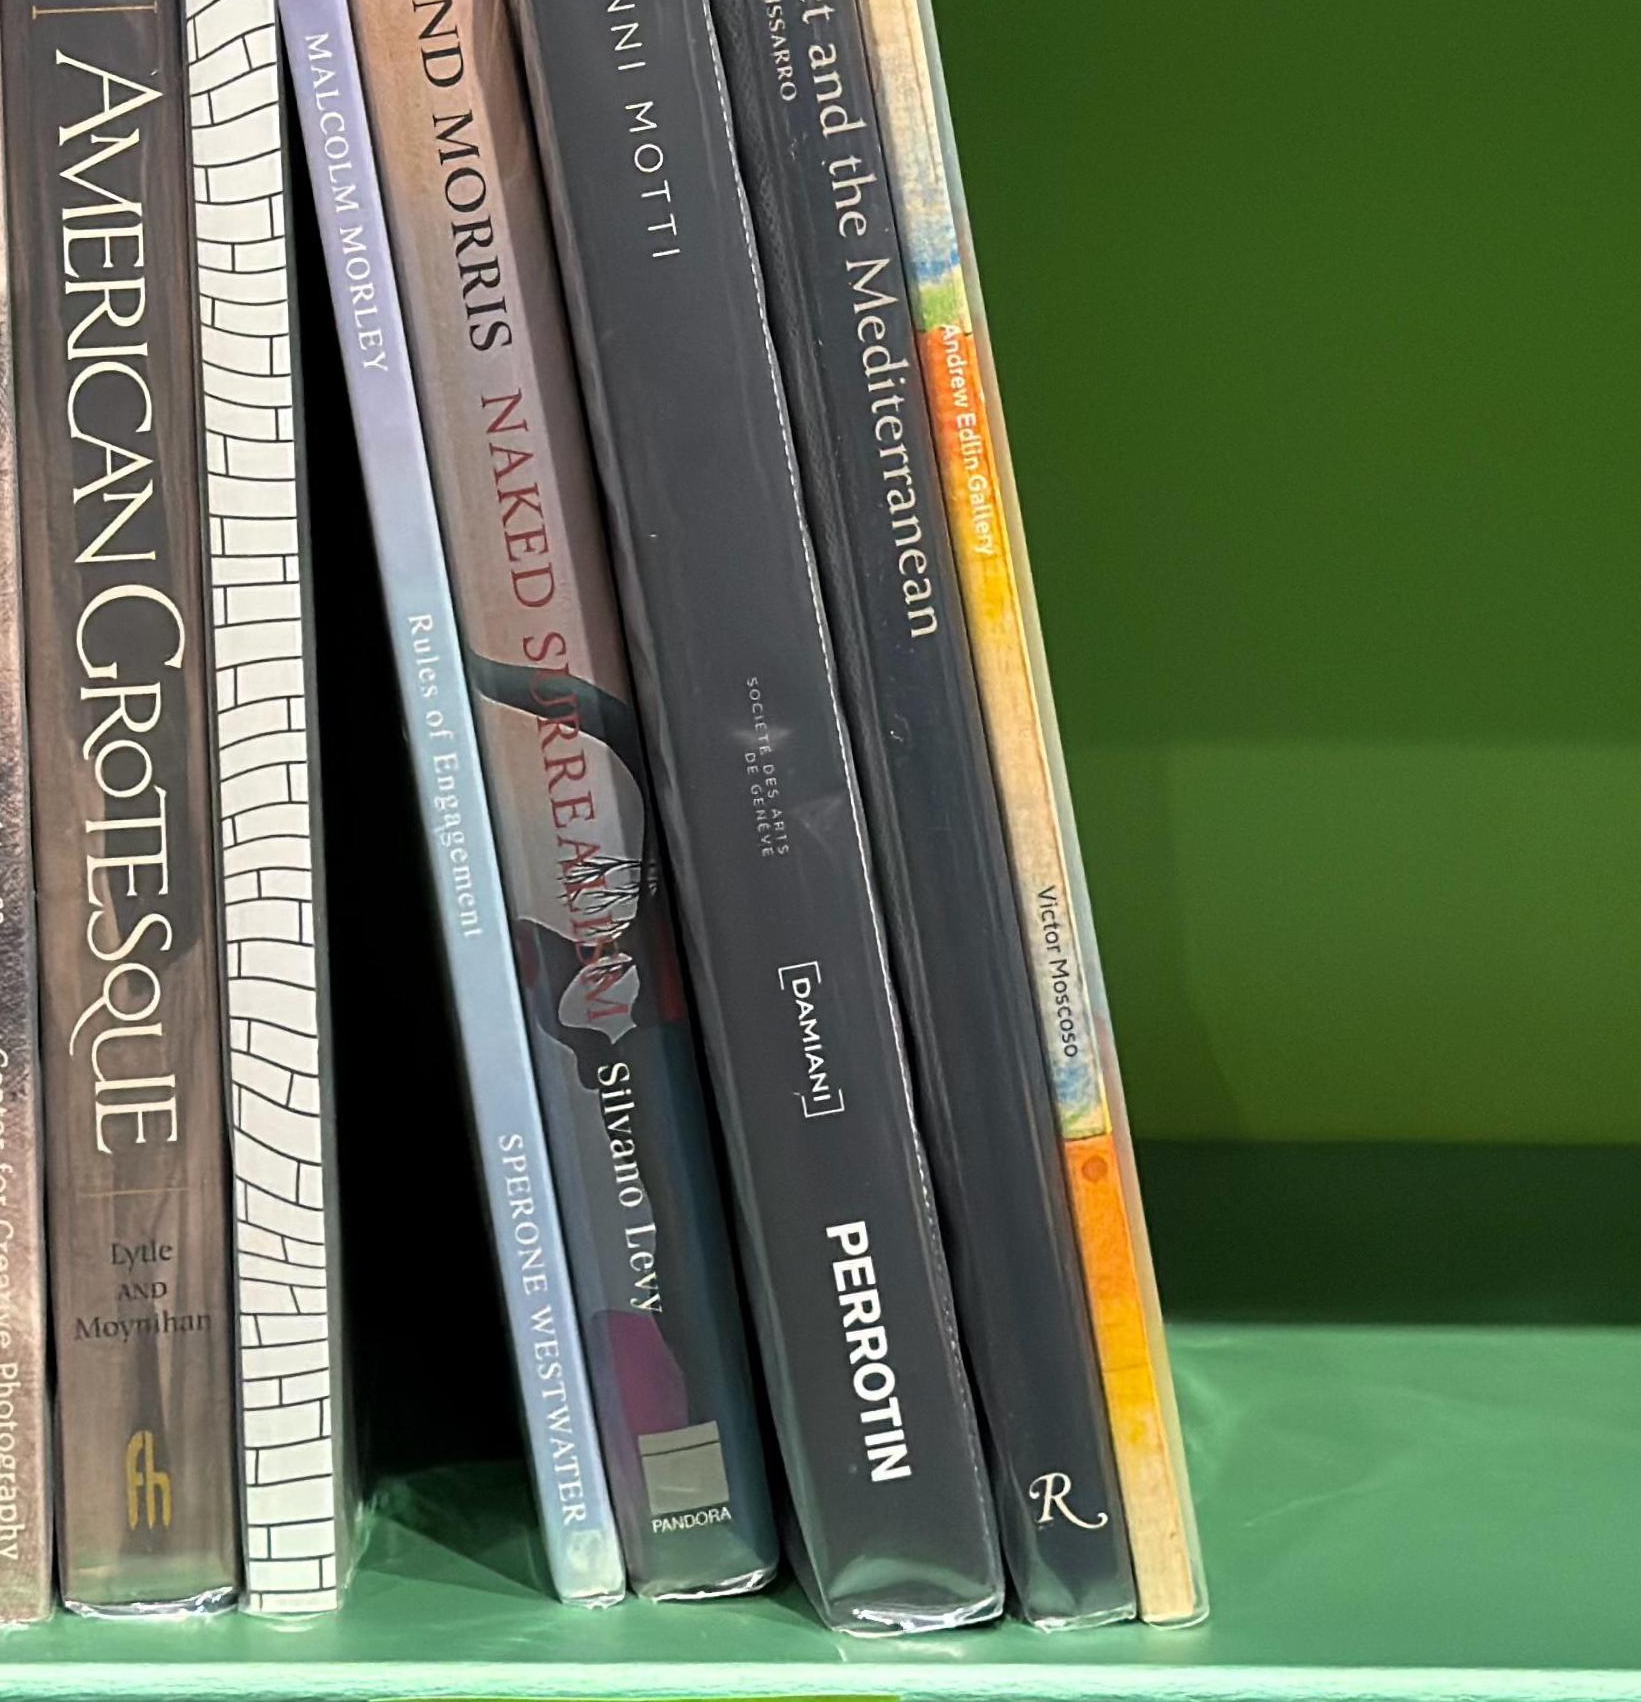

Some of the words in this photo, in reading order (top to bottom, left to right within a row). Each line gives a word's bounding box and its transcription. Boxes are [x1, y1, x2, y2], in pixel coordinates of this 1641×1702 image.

[806, 43, 856, 137] and
[304, 31, 359, 214] MALCOLM
[338, 225, 389, 376] MORLEY
[624, 100, 682, 260] MOTTI
[827, 157, 878, 241] the
[429, 112, 512, 352] MORRIS
[56, 49, 163, 565] AMERICAN
[939, 322, 975, 409] Andrew
[844, 257, 944, 639] Mediterranean
[954, 412, 987, 472] Edlin
[478, 388, 556, 609] NAKED
[963, 475, 998, 557] Gallery
[406, 613, 442, 699] Rules
[423, 710, 452, 742] of
[745, 752, 759, 776] DE
[762, 764, 779, 799] DES
[69, 584, 186, 1155] GROTESQUE
[431, 753, 486, 939] Engagement
[523, 634, 632, 1027] SURREALISM
[770, 808, 790, 856] ARTS
[1035, 884, 1064, 954] Victor
[1048, 958, 1082, 1058] Moscoso
[597, 1062, 653, 1209] Silvano
[111, 1240, 173, 1273] Lytle
[118, 1281, 168, 1301] AND
[623, 1224, 670, 1315] Levy
[75, 1310, 211, 1343] Moynihan
[498, 1132, 549, 1296] SPERONE
[527, 1306, 588, 1526] WESTWATER
[826, 1220, 912, 1482] PERROTIN
[651, 1506, 732, 1533] PANDORA
